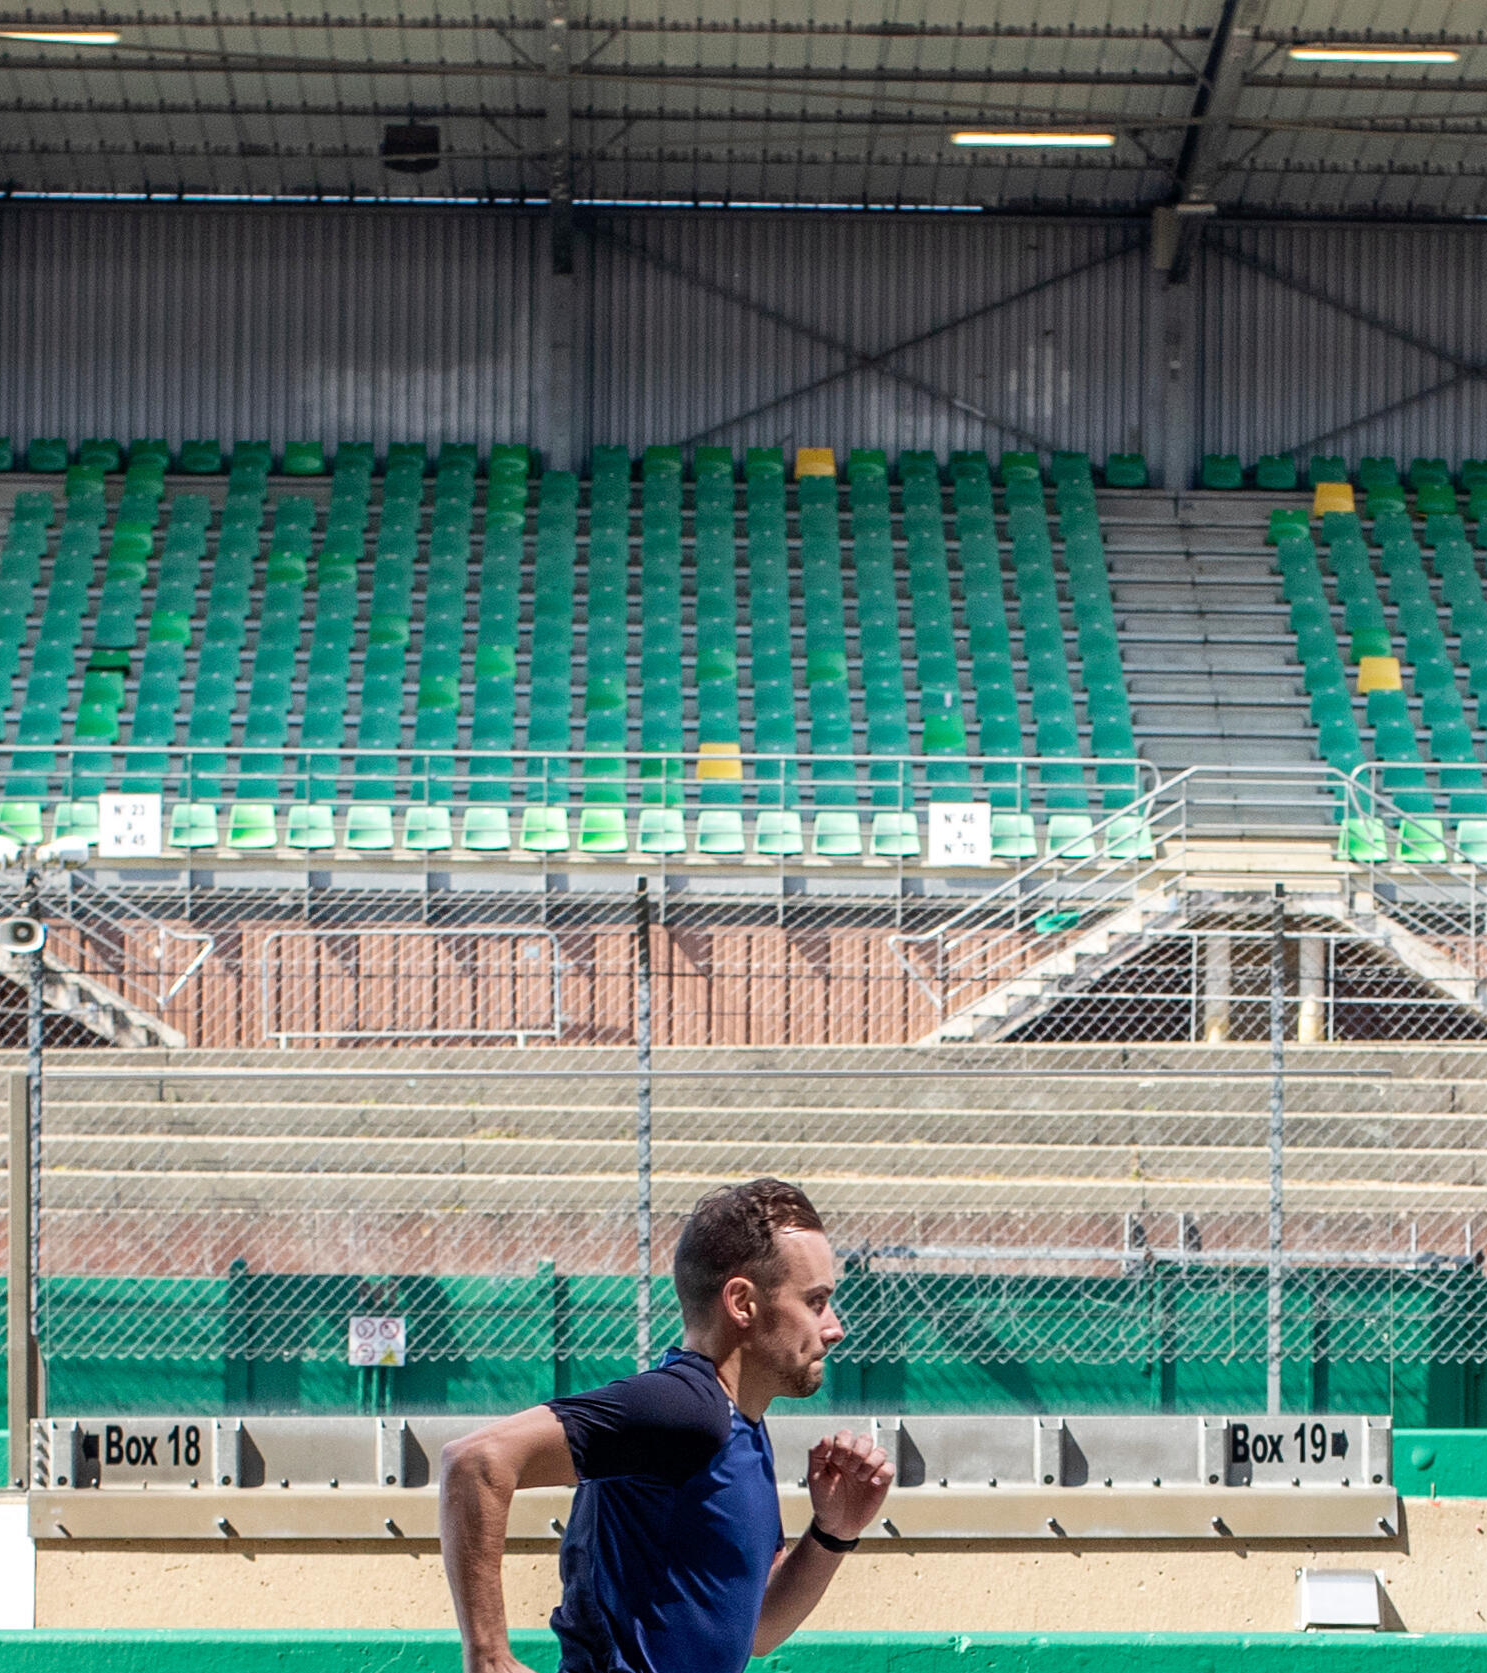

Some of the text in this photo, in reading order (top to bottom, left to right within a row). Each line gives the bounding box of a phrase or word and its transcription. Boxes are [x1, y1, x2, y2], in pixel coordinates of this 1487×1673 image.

[105, 1424, 201, 1467] Box 18
[1231, 1423, 1328, 1464] Box 19
